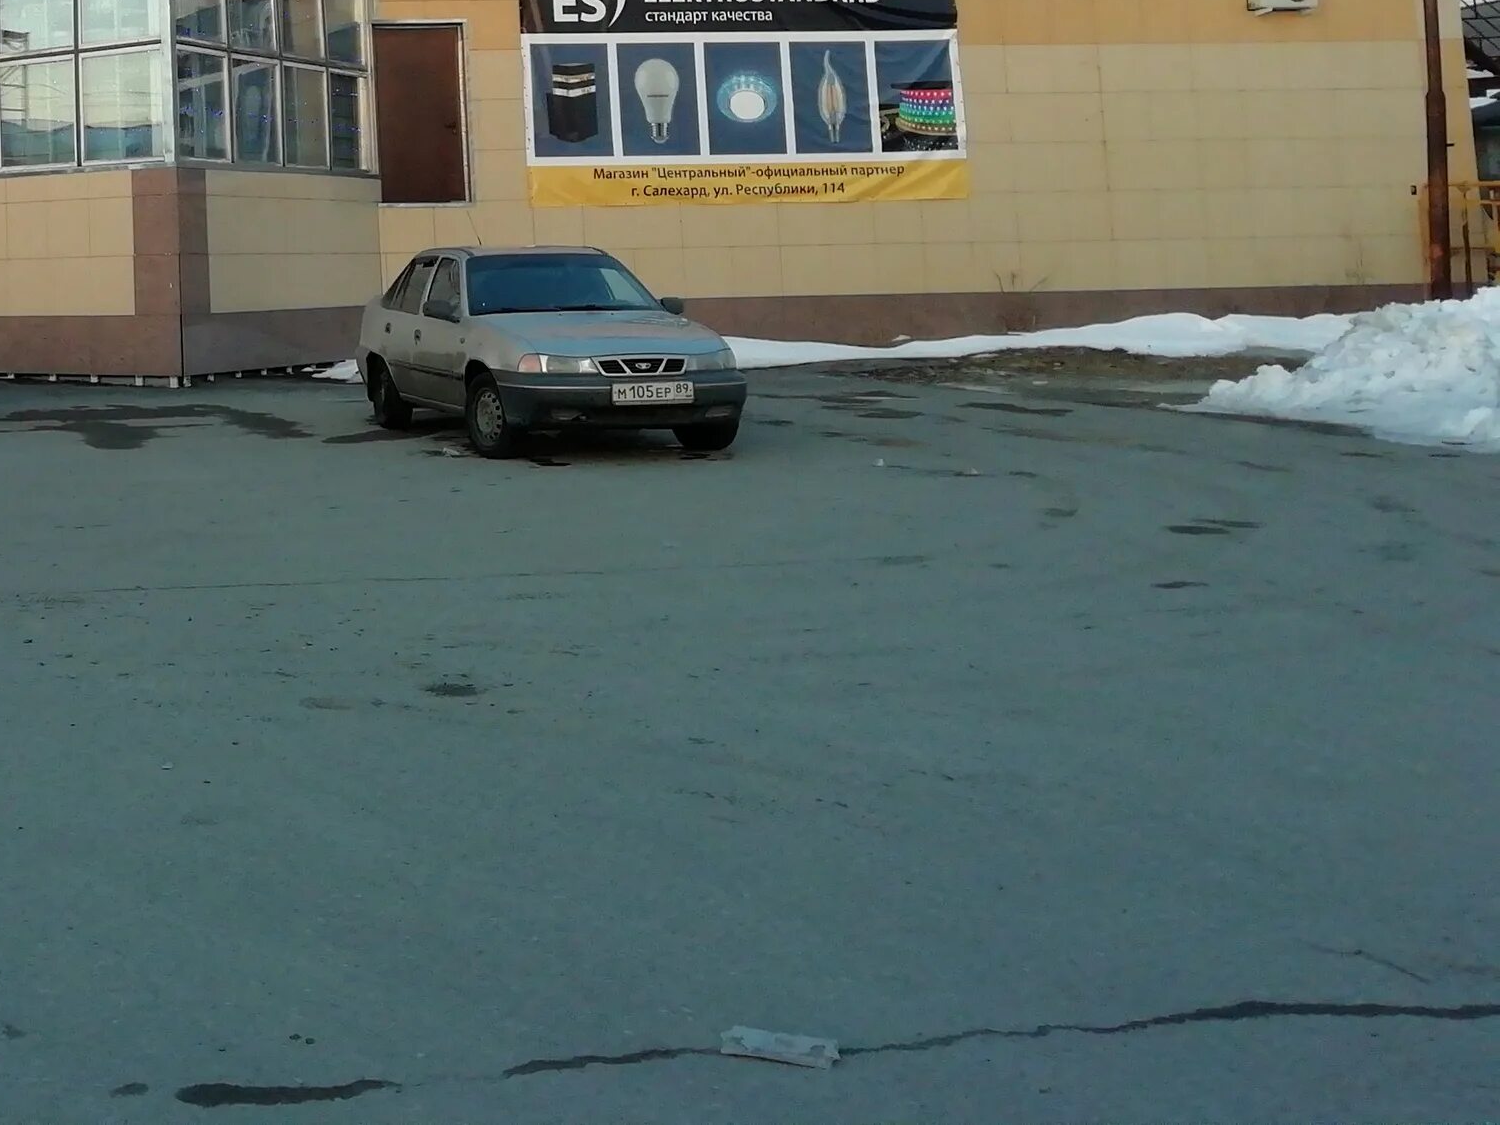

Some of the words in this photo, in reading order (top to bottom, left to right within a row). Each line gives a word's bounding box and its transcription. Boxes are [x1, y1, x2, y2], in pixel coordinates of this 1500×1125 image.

[645, 10, 710, 24] стандарт
[711, 9, 773, 22] качества
[593, 168, 649, 180] Магазин
[851, 165, 905, 178] партнер
[631, 187, 640, 197] г.
[643, 184, 710, 198] Салехард,
[713, 186, 733, 198] ул.
[736, 183, 819, 198] Республики,
[822, 182, 845, 194] 114
